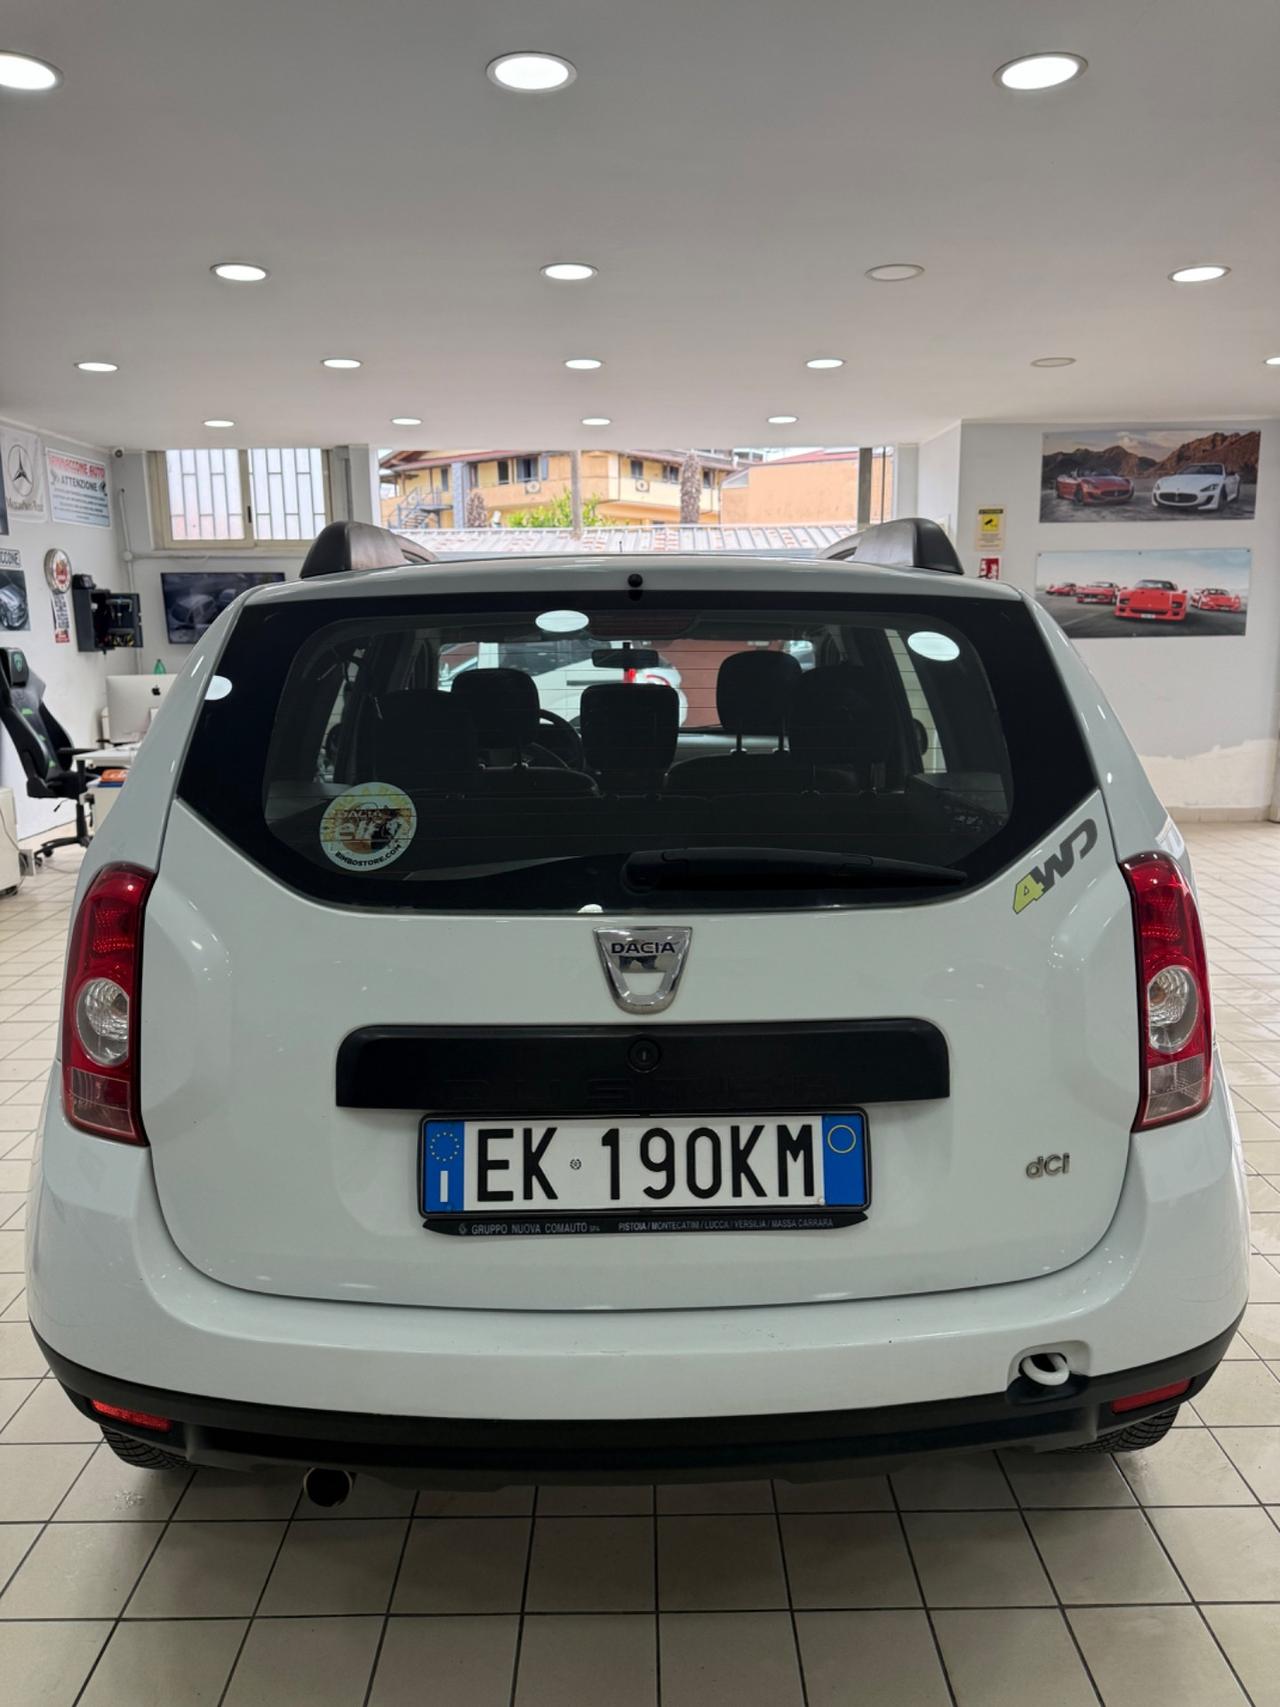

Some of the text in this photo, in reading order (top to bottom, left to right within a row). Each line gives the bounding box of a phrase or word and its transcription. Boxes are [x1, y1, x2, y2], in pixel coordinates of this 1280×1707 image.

[61, 474, 98, 492] ATTENZIONE
[1012, 817, 1099, 915] 4WD
[611, 942, 675, 954] DACIA
[471, 1223, 508, 1235] GRUPPO
[511, 1223, 541, 1234] NUOVA
[544, 1222, 588, 1233] COMAUTO
[618, 1221, 646, 1231] PISTOIA
